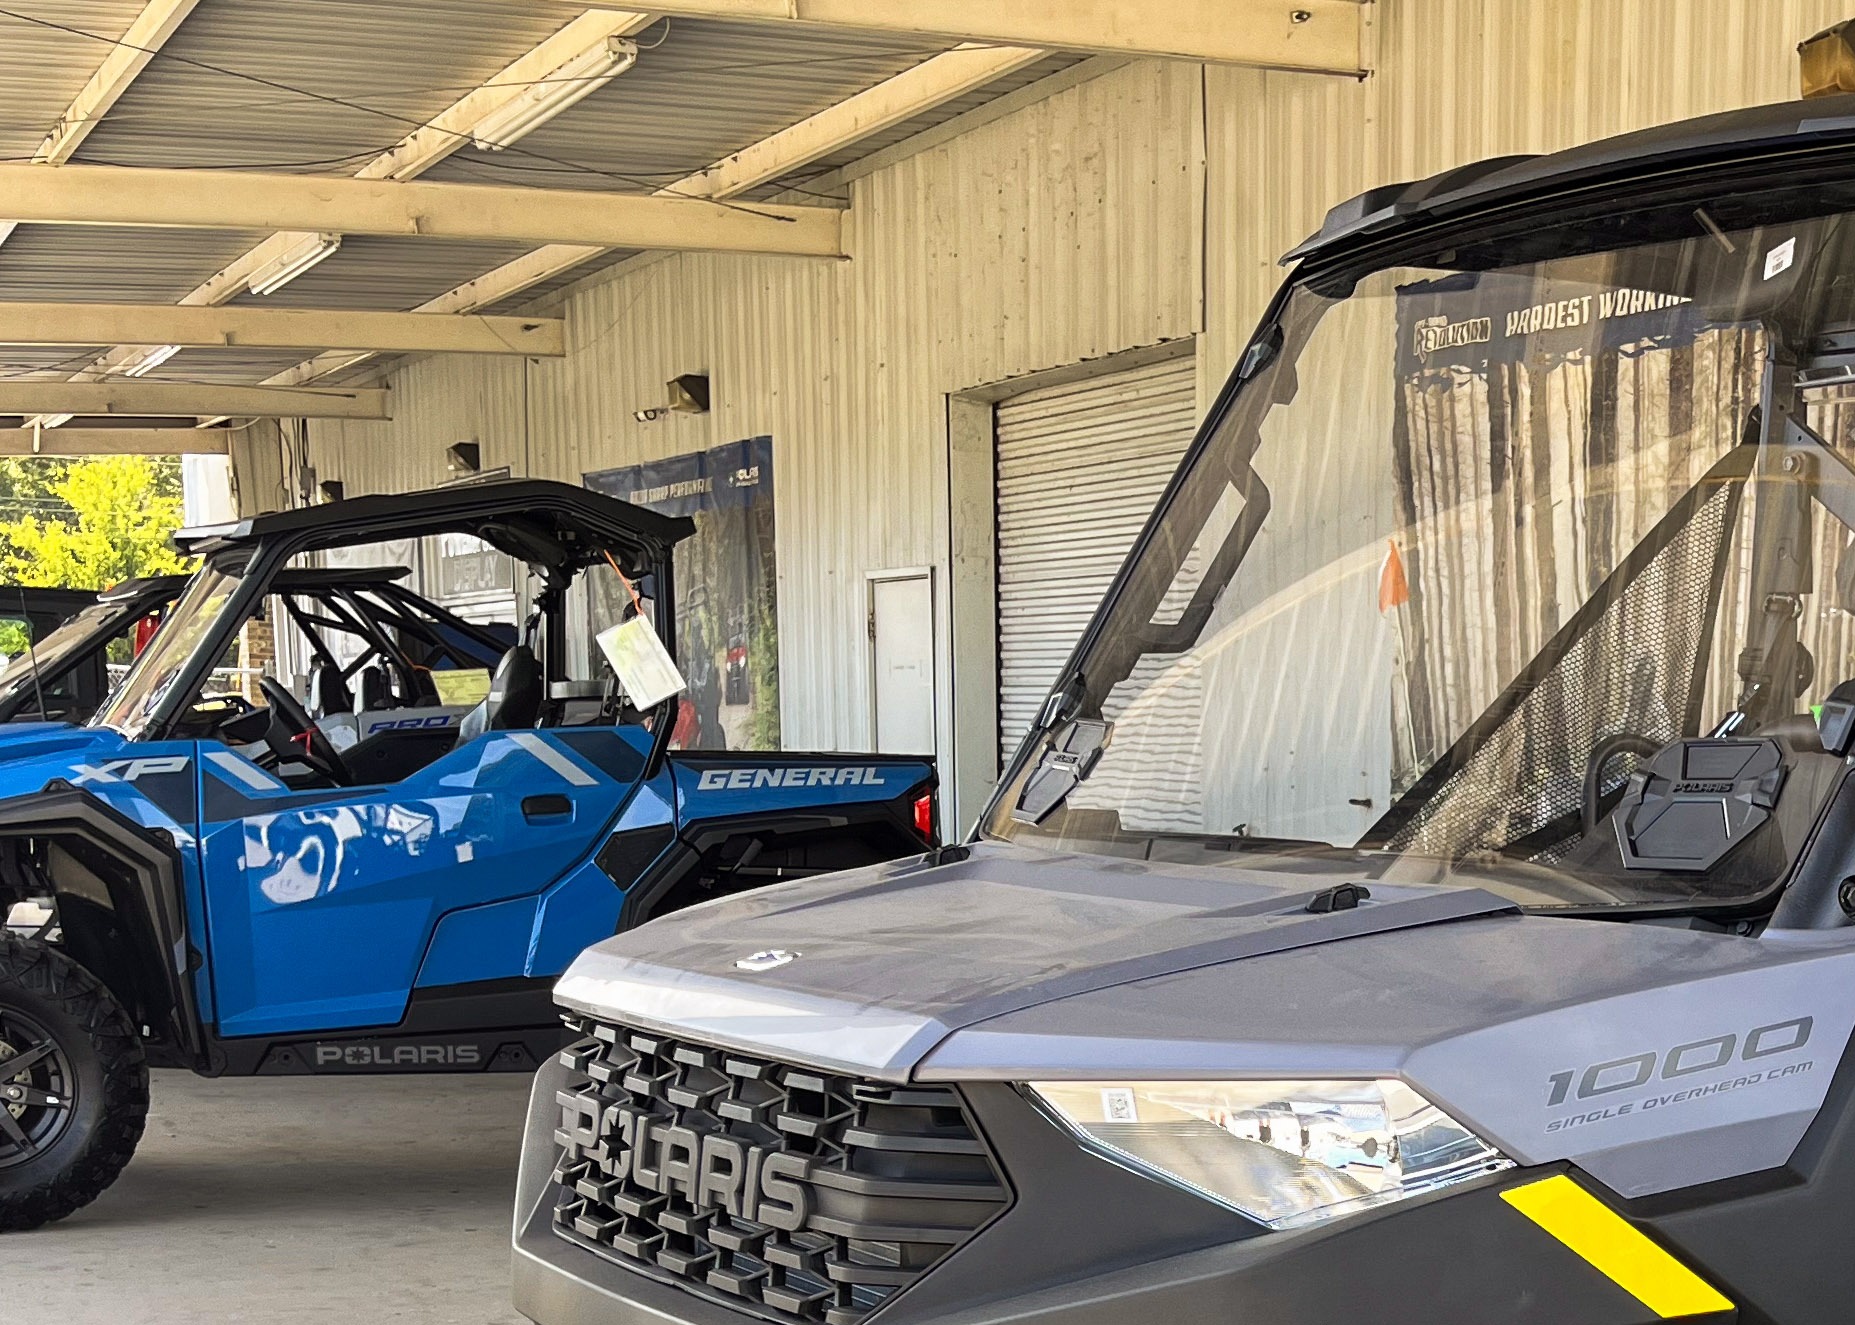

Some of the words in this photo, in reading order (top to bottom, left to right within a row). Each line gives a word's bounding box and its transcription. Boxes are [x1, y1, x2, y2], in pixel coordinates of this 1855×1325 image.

[1505, 295, 1592, 337] HARDEST
[1598, 287, 1693, 319] WORKIN
[1413, 316, 1491, 363] REVOLUTION
[368, 715, 451, 734] PRO
[67, 756, 189, 787] XP
[697, 767, 885, 790] GENERAL
[1672, 782, 1734, 793] POLARIS
[316, 1045, 480, 1065] POLARIS
[1546, 1015, 1814, 1107] 1000
[1545, 1103, 1634, 1133] SINGLE
[1642, 1073, 1762, 1111] OVERHEAD
[1766, 1060, 1814, 1080] CAM
[560, 1091, 811, 1232] POLARIS
